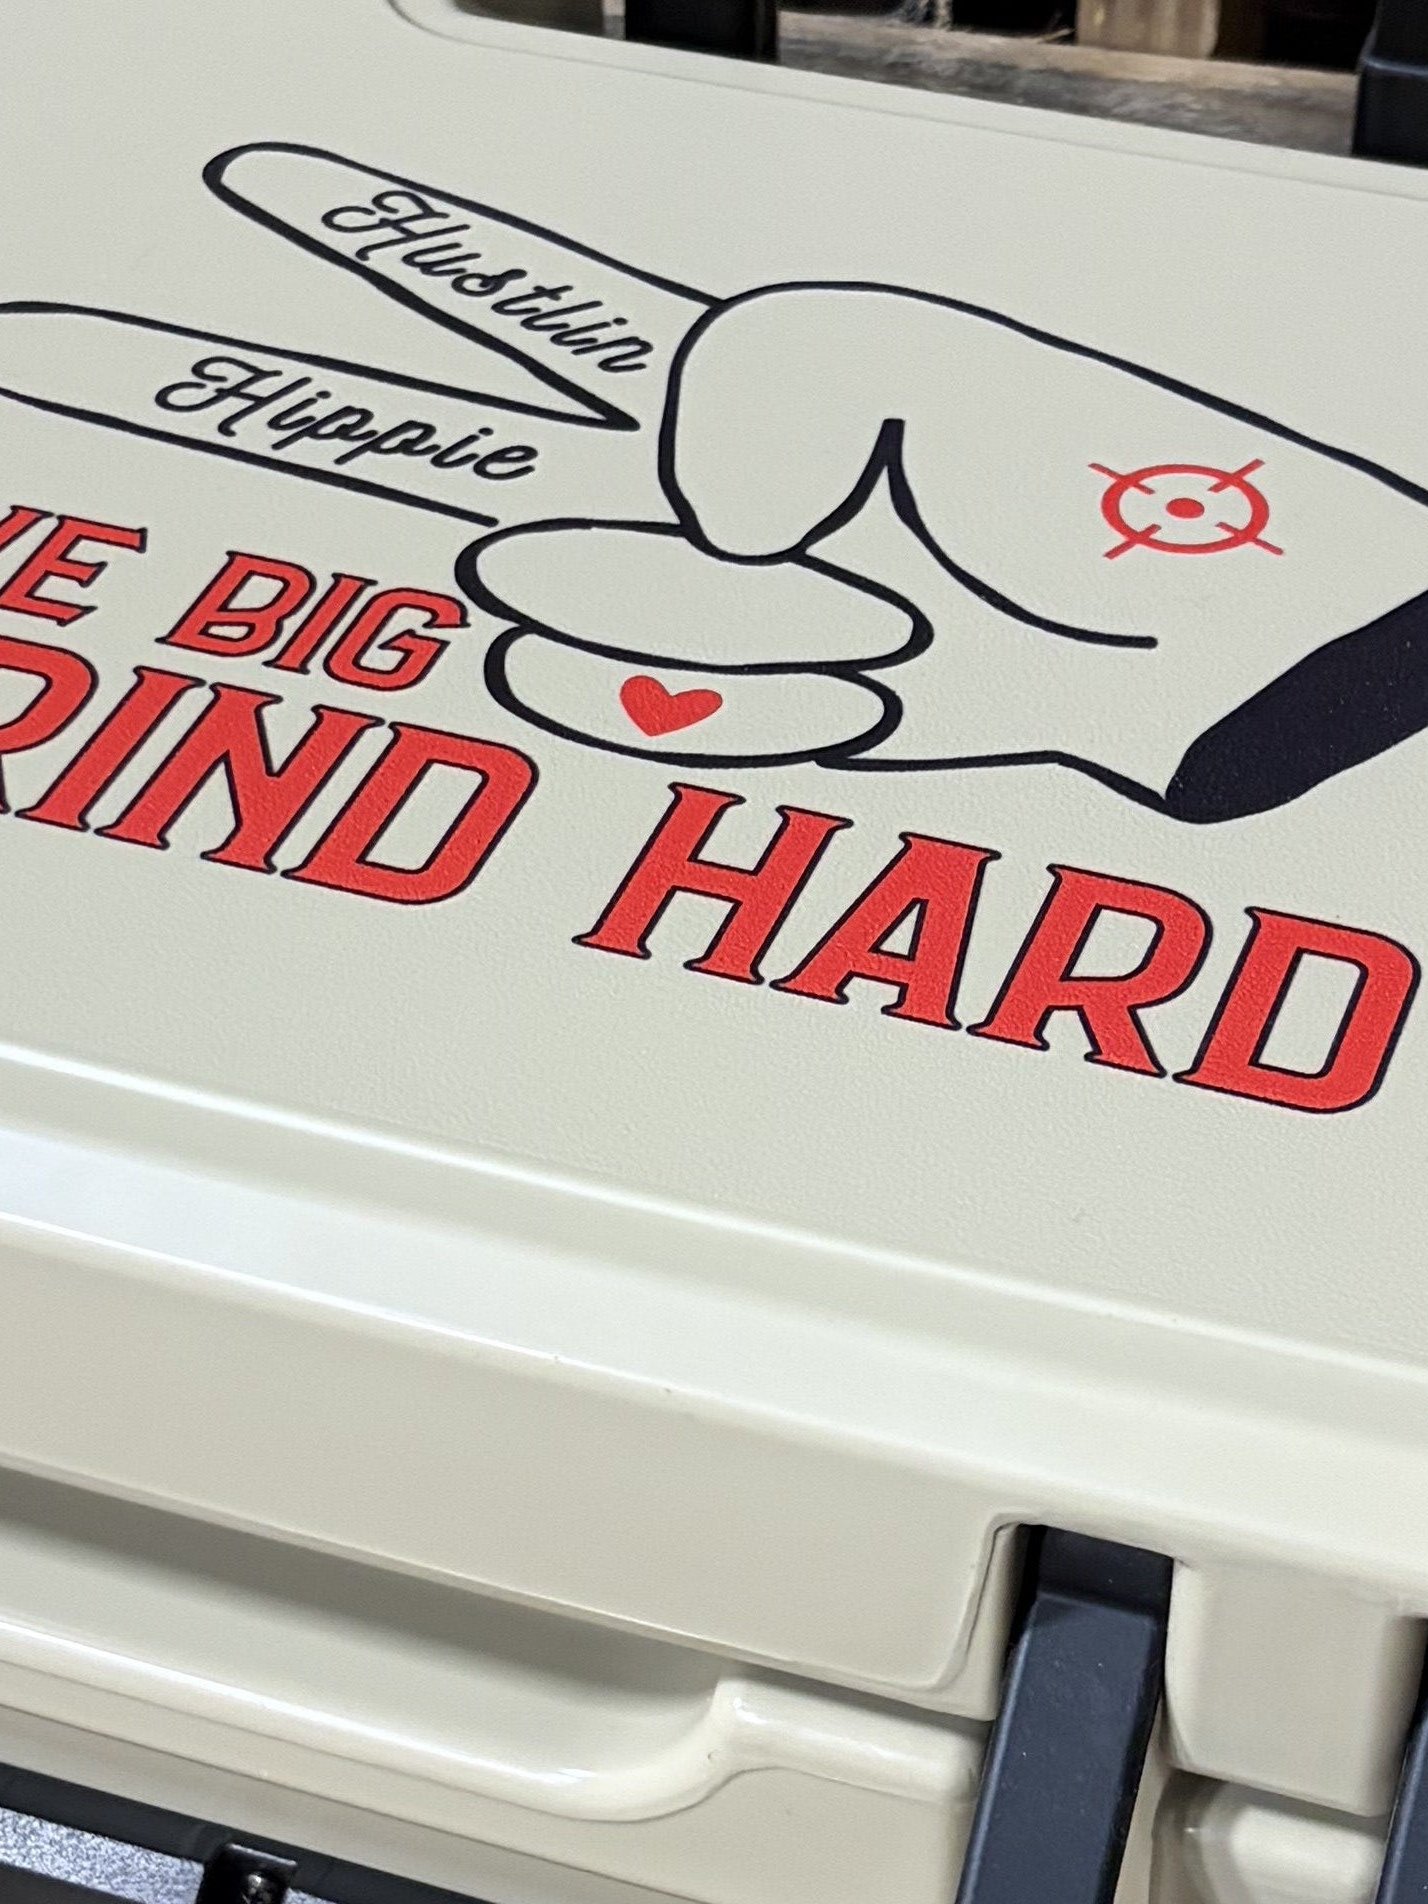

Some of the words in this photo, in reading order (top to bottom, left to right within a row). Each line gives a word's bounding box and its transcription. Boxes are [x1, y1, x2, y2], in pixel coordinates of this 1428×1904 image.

[320, 190, 654, 373] Hustlin
[154, 356, 539, 480] Hippie
[158, 549, 468, 693] BIG
[575, 781, 1420, 1115] HARD
